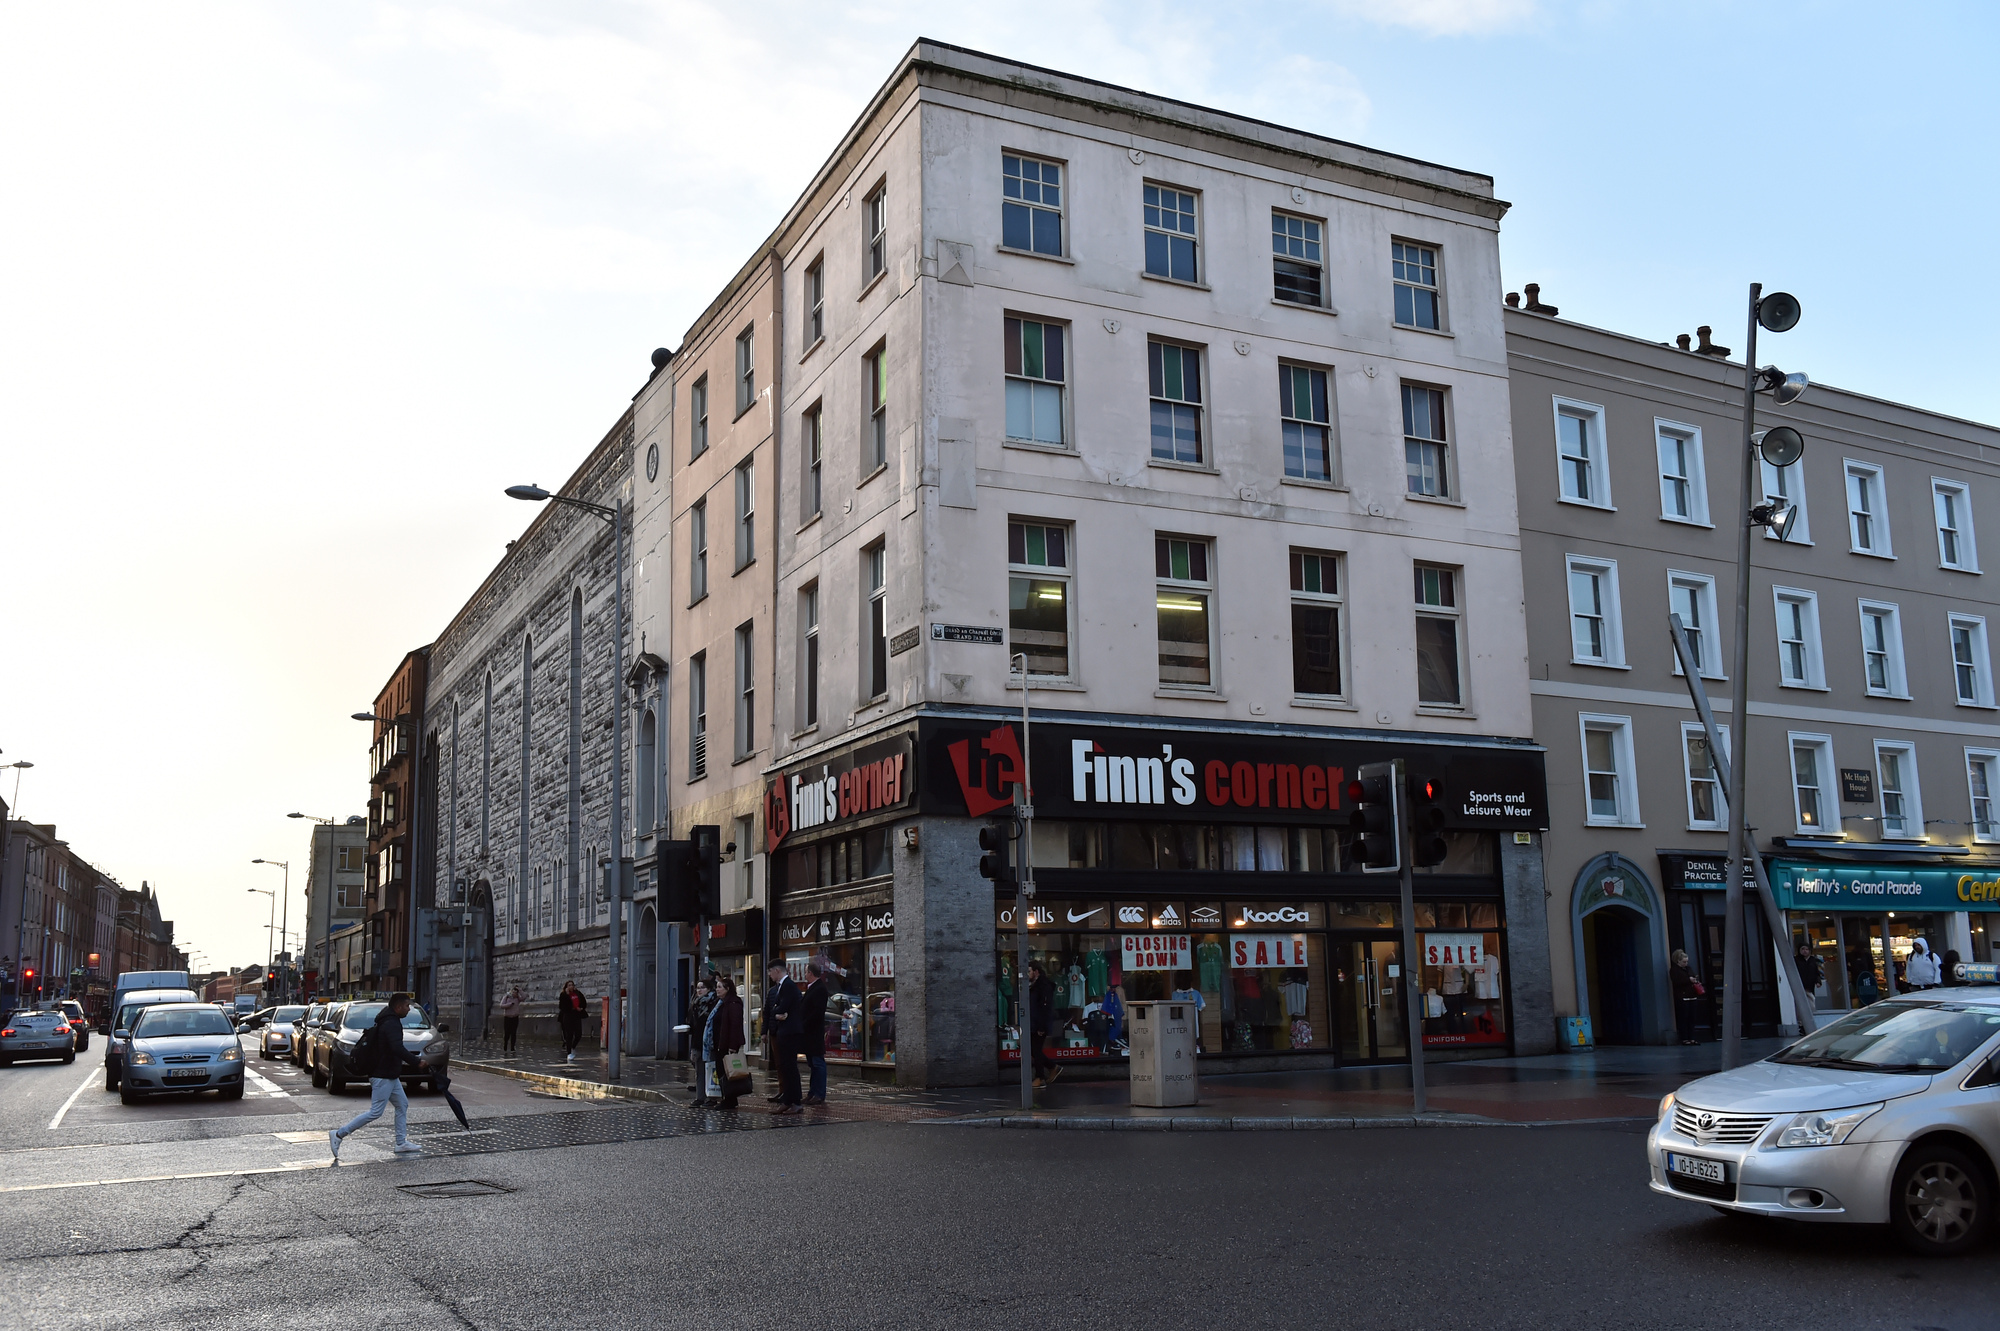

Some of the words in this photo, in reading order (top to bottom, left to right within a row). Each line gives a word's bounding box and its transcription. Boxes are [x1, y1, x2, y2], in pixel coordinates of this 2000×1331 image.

[1072, 739, 1197, 806] Finn's
[1204, 759, 1344, 810] corner
[1854, 773, 1870, 784] Hugh
[791, 764, 837, 832] Finn's
[839, 752, 905, 819] corner
[1849, 783, 1867, 792] House
[1469, 790, 1502, 804] Sports
[1505, 792, 1525, 803] and
[1463, 804, 1501, 816] Leisure
[1503, 805, 1532, 816] Wear
[1687, 861, 1717, 870] DENTAL
[1684, 871, 1722, 880] PRACTICE
[1796, 878, 1840, 897] Herlihy's
[1851, 880, 1885, 895] Grand
[1886, 881, 1922, 895] Parade
[867, 912, 894, 931] KooG
[1243, 907, 1309, 922] KooGa
[1125, 936, 1187, 952] CLOSING
[1136, 952, 1178, 967] DOWN
[1235, 941, 1304, 966] SALE
[1429, 945, 1478, 964] SALE
[872, 955, 893, 976] SAL
[1165, 1073, 1193, 1082] BRUSCAR
[1679, 1158, 1719, 1179] 10-D-16225
